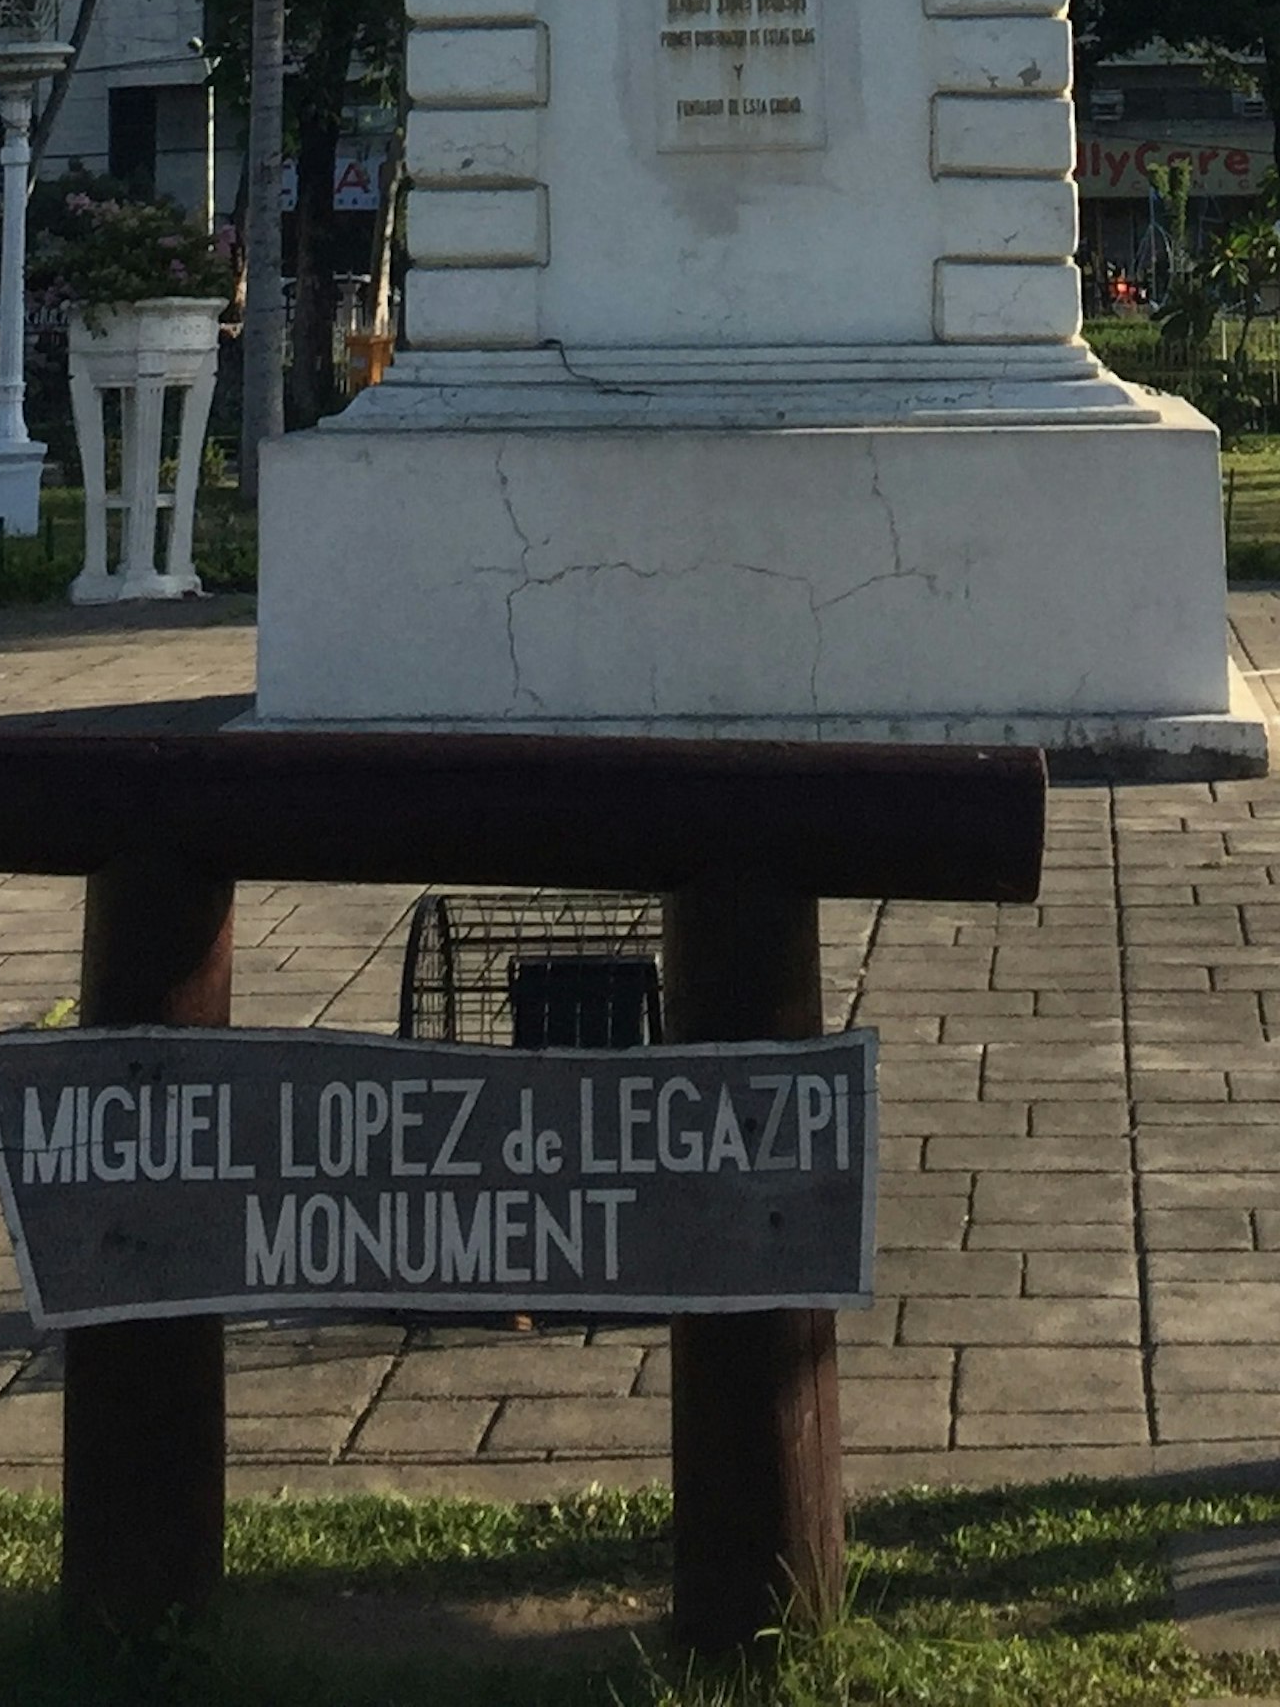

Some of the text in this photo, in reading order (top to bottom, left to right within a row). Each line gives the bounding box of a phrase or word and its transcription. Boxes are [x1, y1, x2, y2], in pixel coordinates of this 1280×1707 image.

[733, 63, 743, 80] Y
[22, 1074, 851, 1184] MIGUEL LOPEZ de LEGAZPI
[245, 1188, 637, 1286] MONUMENT
